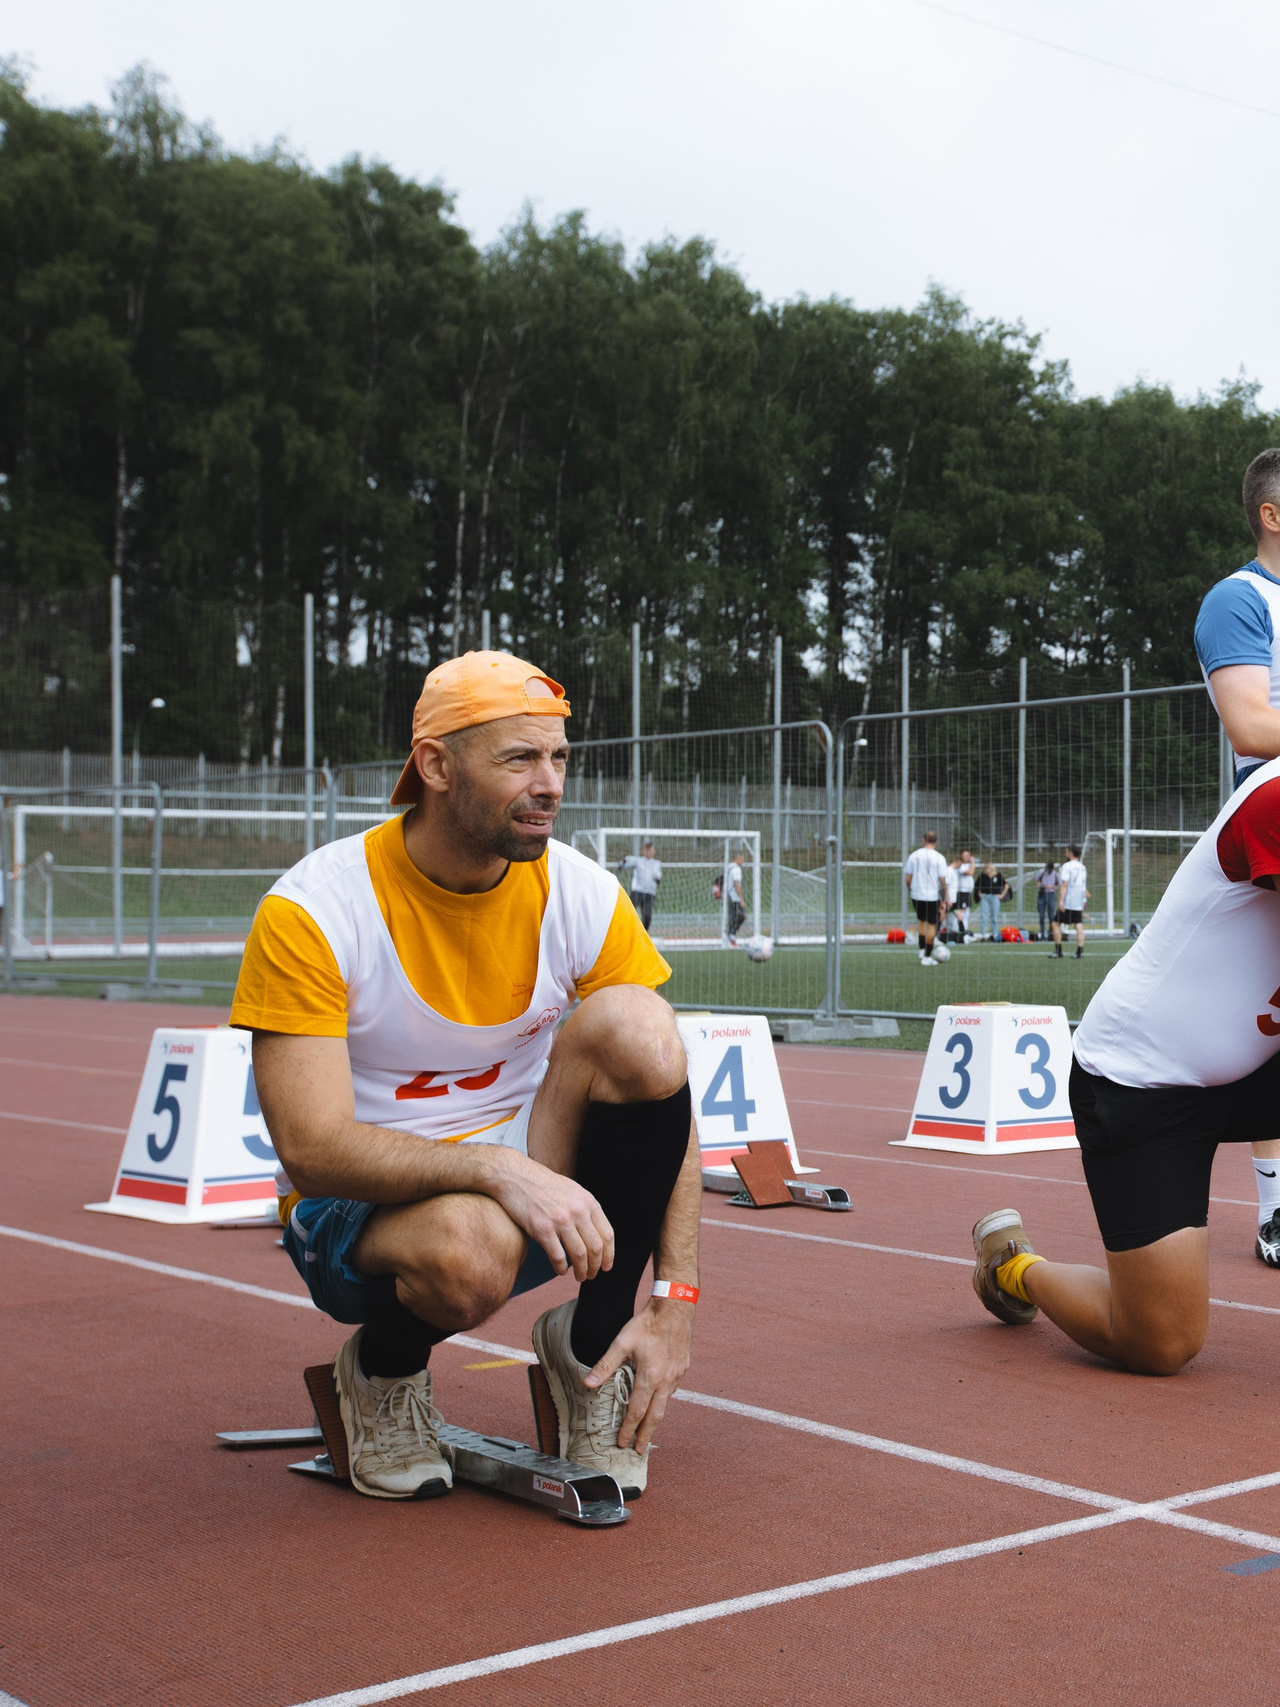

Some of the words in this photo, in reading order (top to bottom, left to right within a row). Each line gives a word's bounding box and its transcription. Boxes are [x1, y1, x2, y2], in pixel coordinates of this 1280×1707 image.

[711, 1026, 752, 1040] polanik
[954, 1015, 982, 1027] polanik
[1021, 1015, 1054, 1028] polanik
[700, 1045, 756, 1132] 4
[939, 1032, 973, 1110] 3
[1015, 1032, 1057, 1110] 3
[147, 1063, 188, 1163] 5
[541, 1480, 563, 1494] polanik
